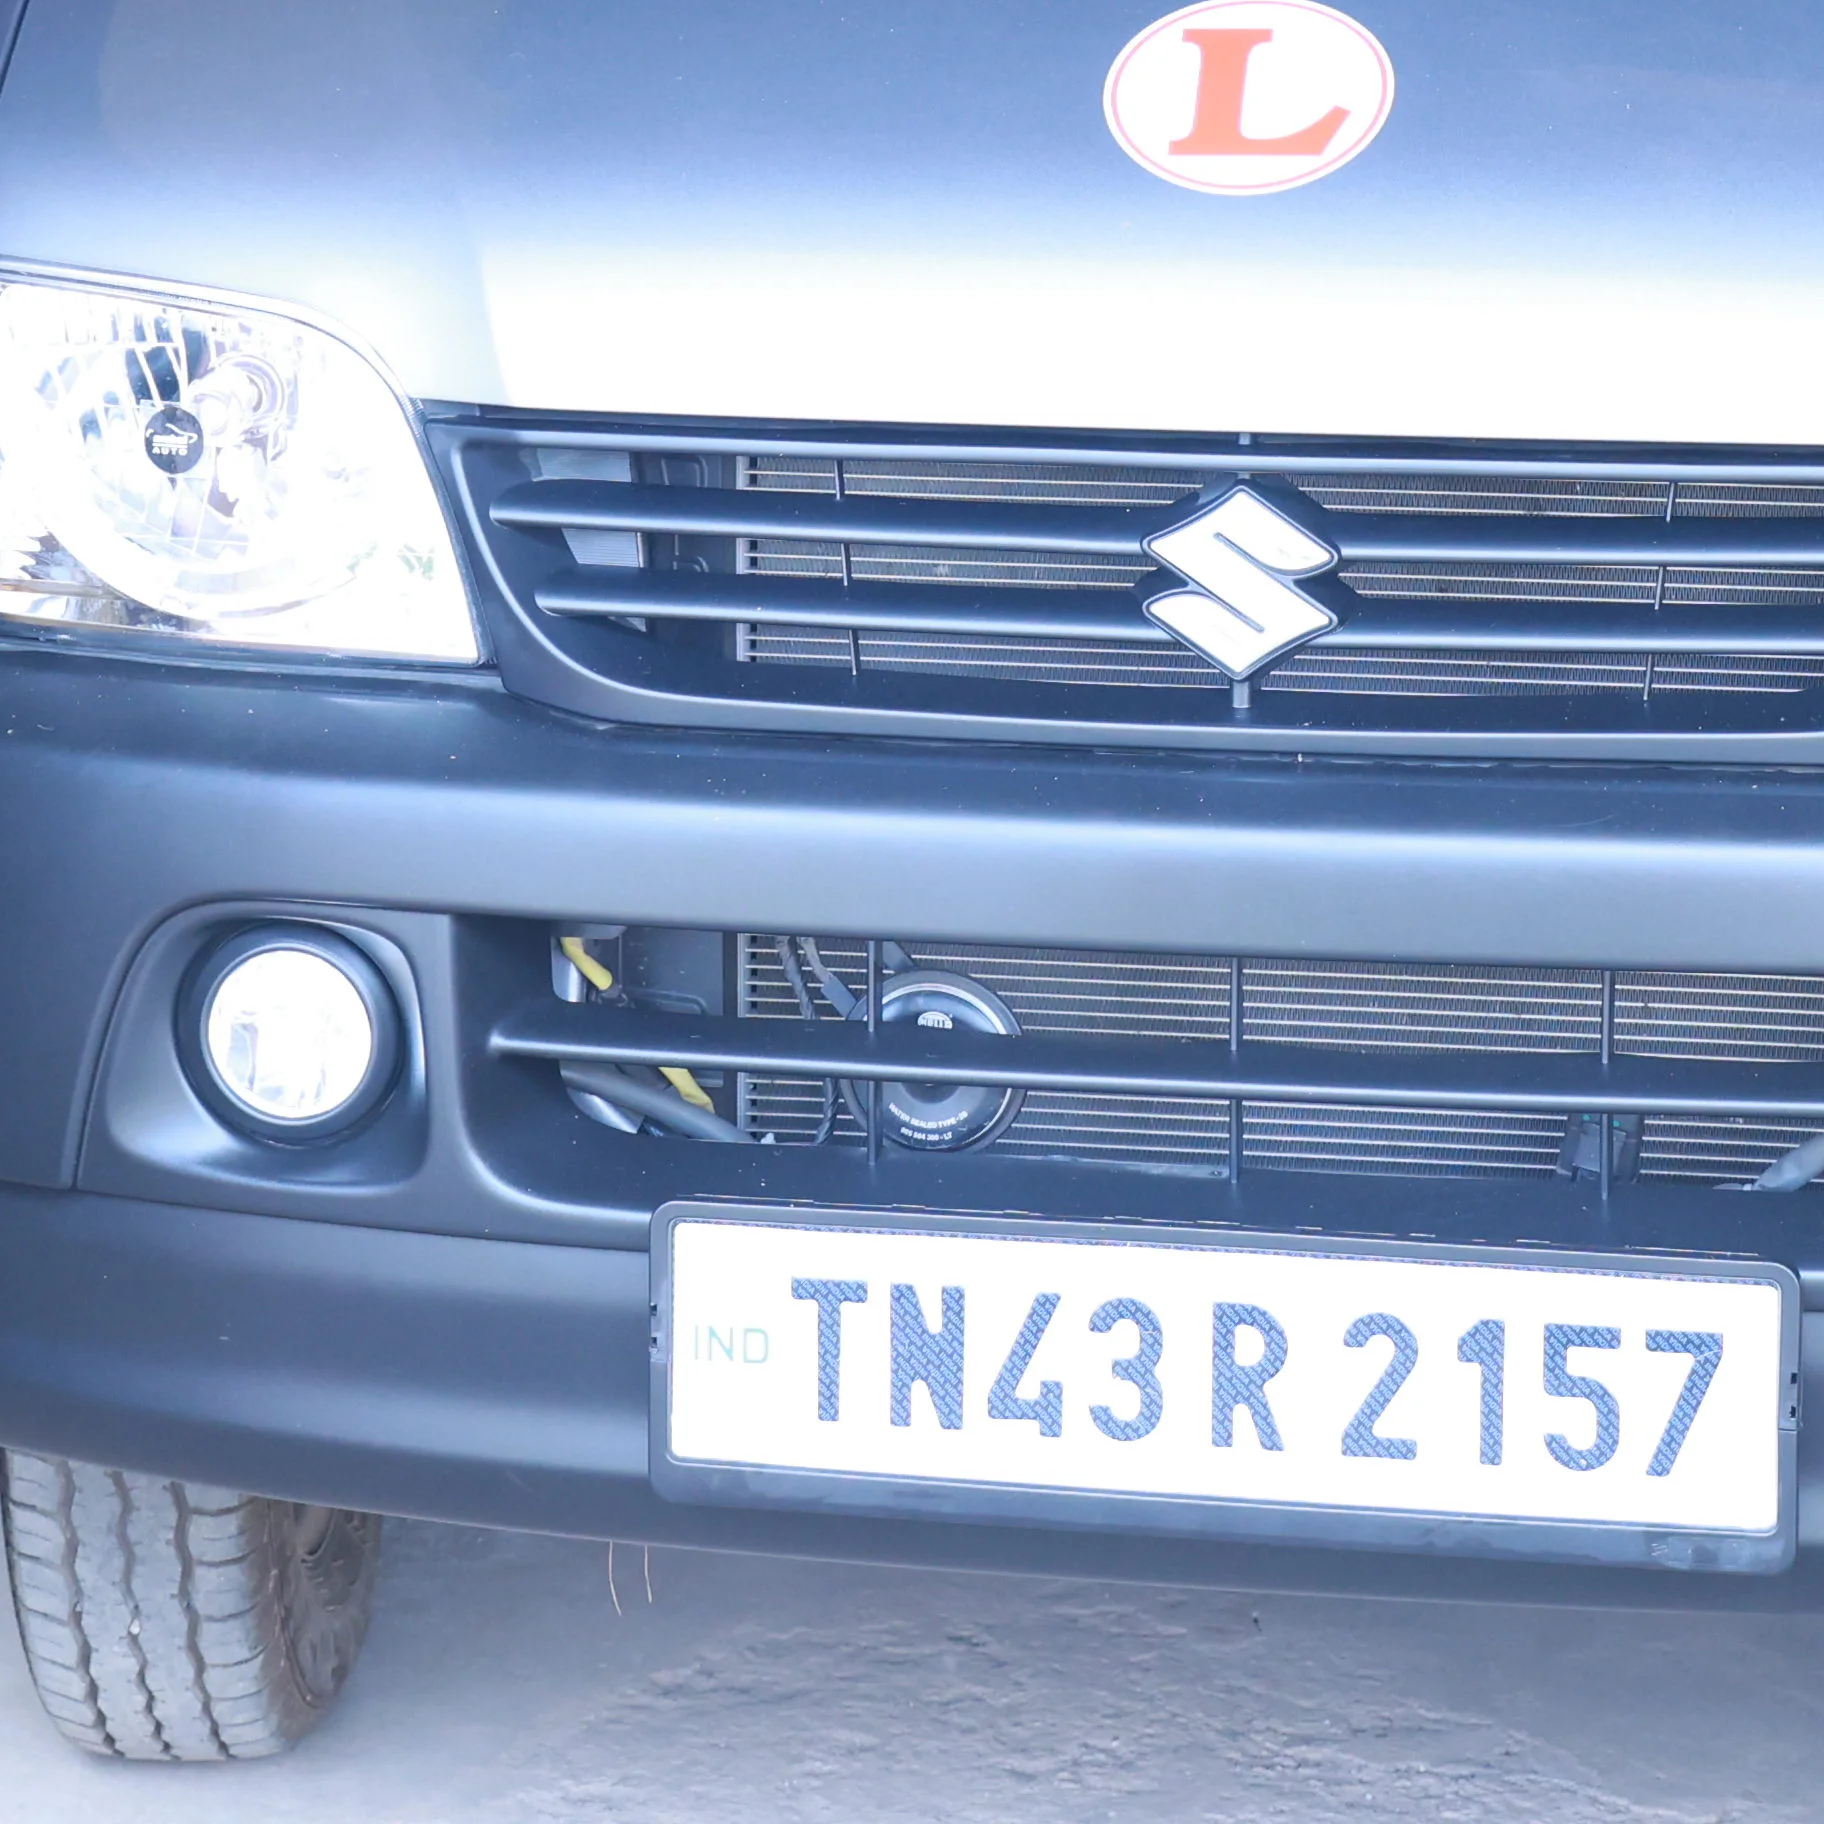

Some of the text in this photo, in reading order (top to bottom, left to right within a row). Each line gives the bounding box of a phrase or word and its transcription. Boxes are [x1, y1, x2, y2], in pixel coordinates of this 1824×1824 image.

[1167, 28, 1352, 157] L
[692, 1323, 770, 1364] IND
[791, 1277, 1725, 1477] TN43 R 2157
